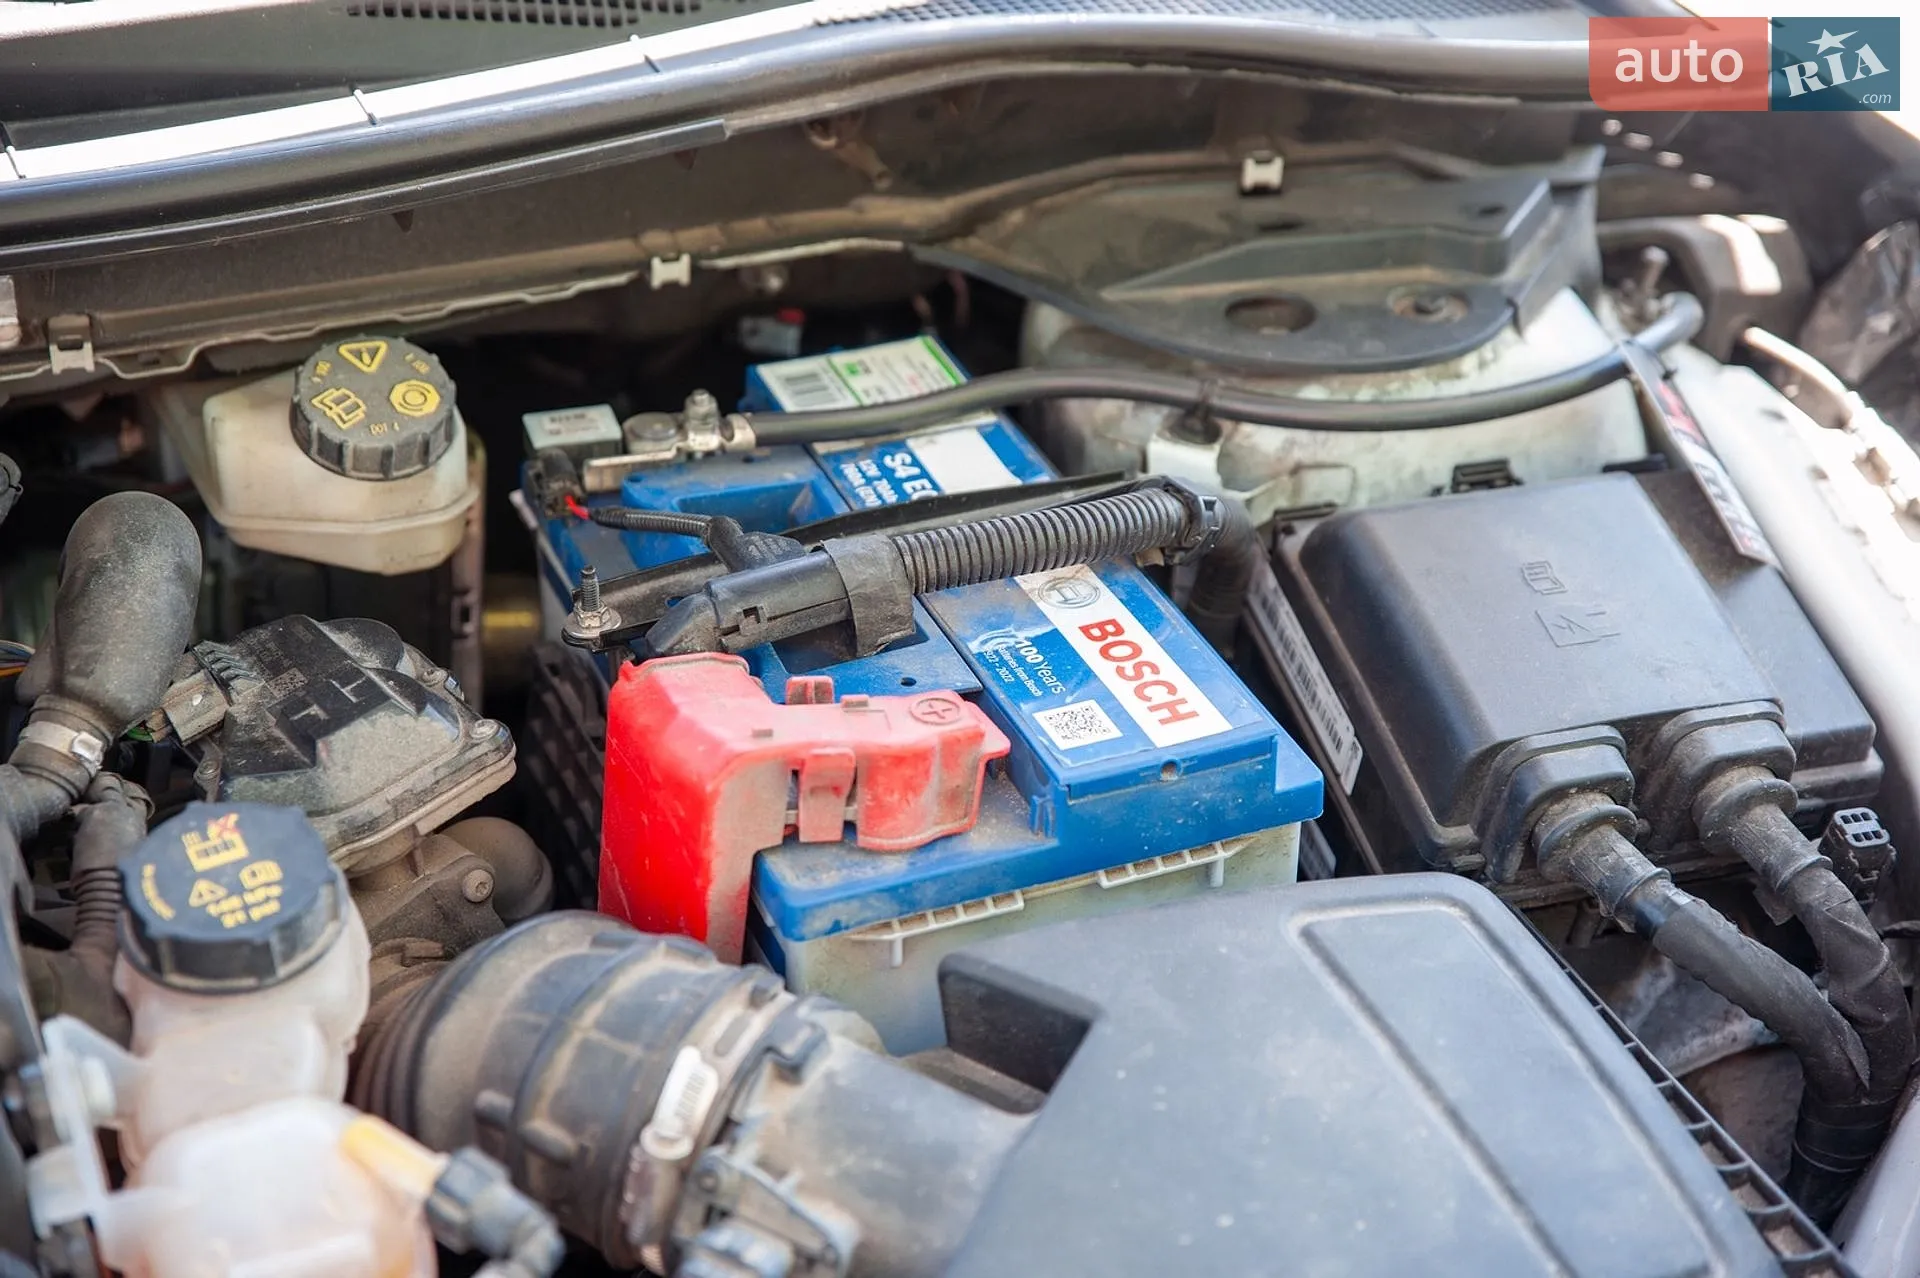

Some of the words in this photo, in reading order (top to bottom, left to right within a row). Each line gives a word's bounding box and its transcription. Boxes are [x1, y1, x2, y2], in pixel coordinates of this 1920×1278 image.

[883, 452, 921, 479] S4
[996, 667, 1015, 683] 2022
[997, 644, 1019, 669] atteries
[1024, 679, 1044, 697] Bosch
[1014, 638, 1044, 664] 100
[1034, 661, 1066, 694] Years
[1078, 618, 1200, 725] BOSCH
